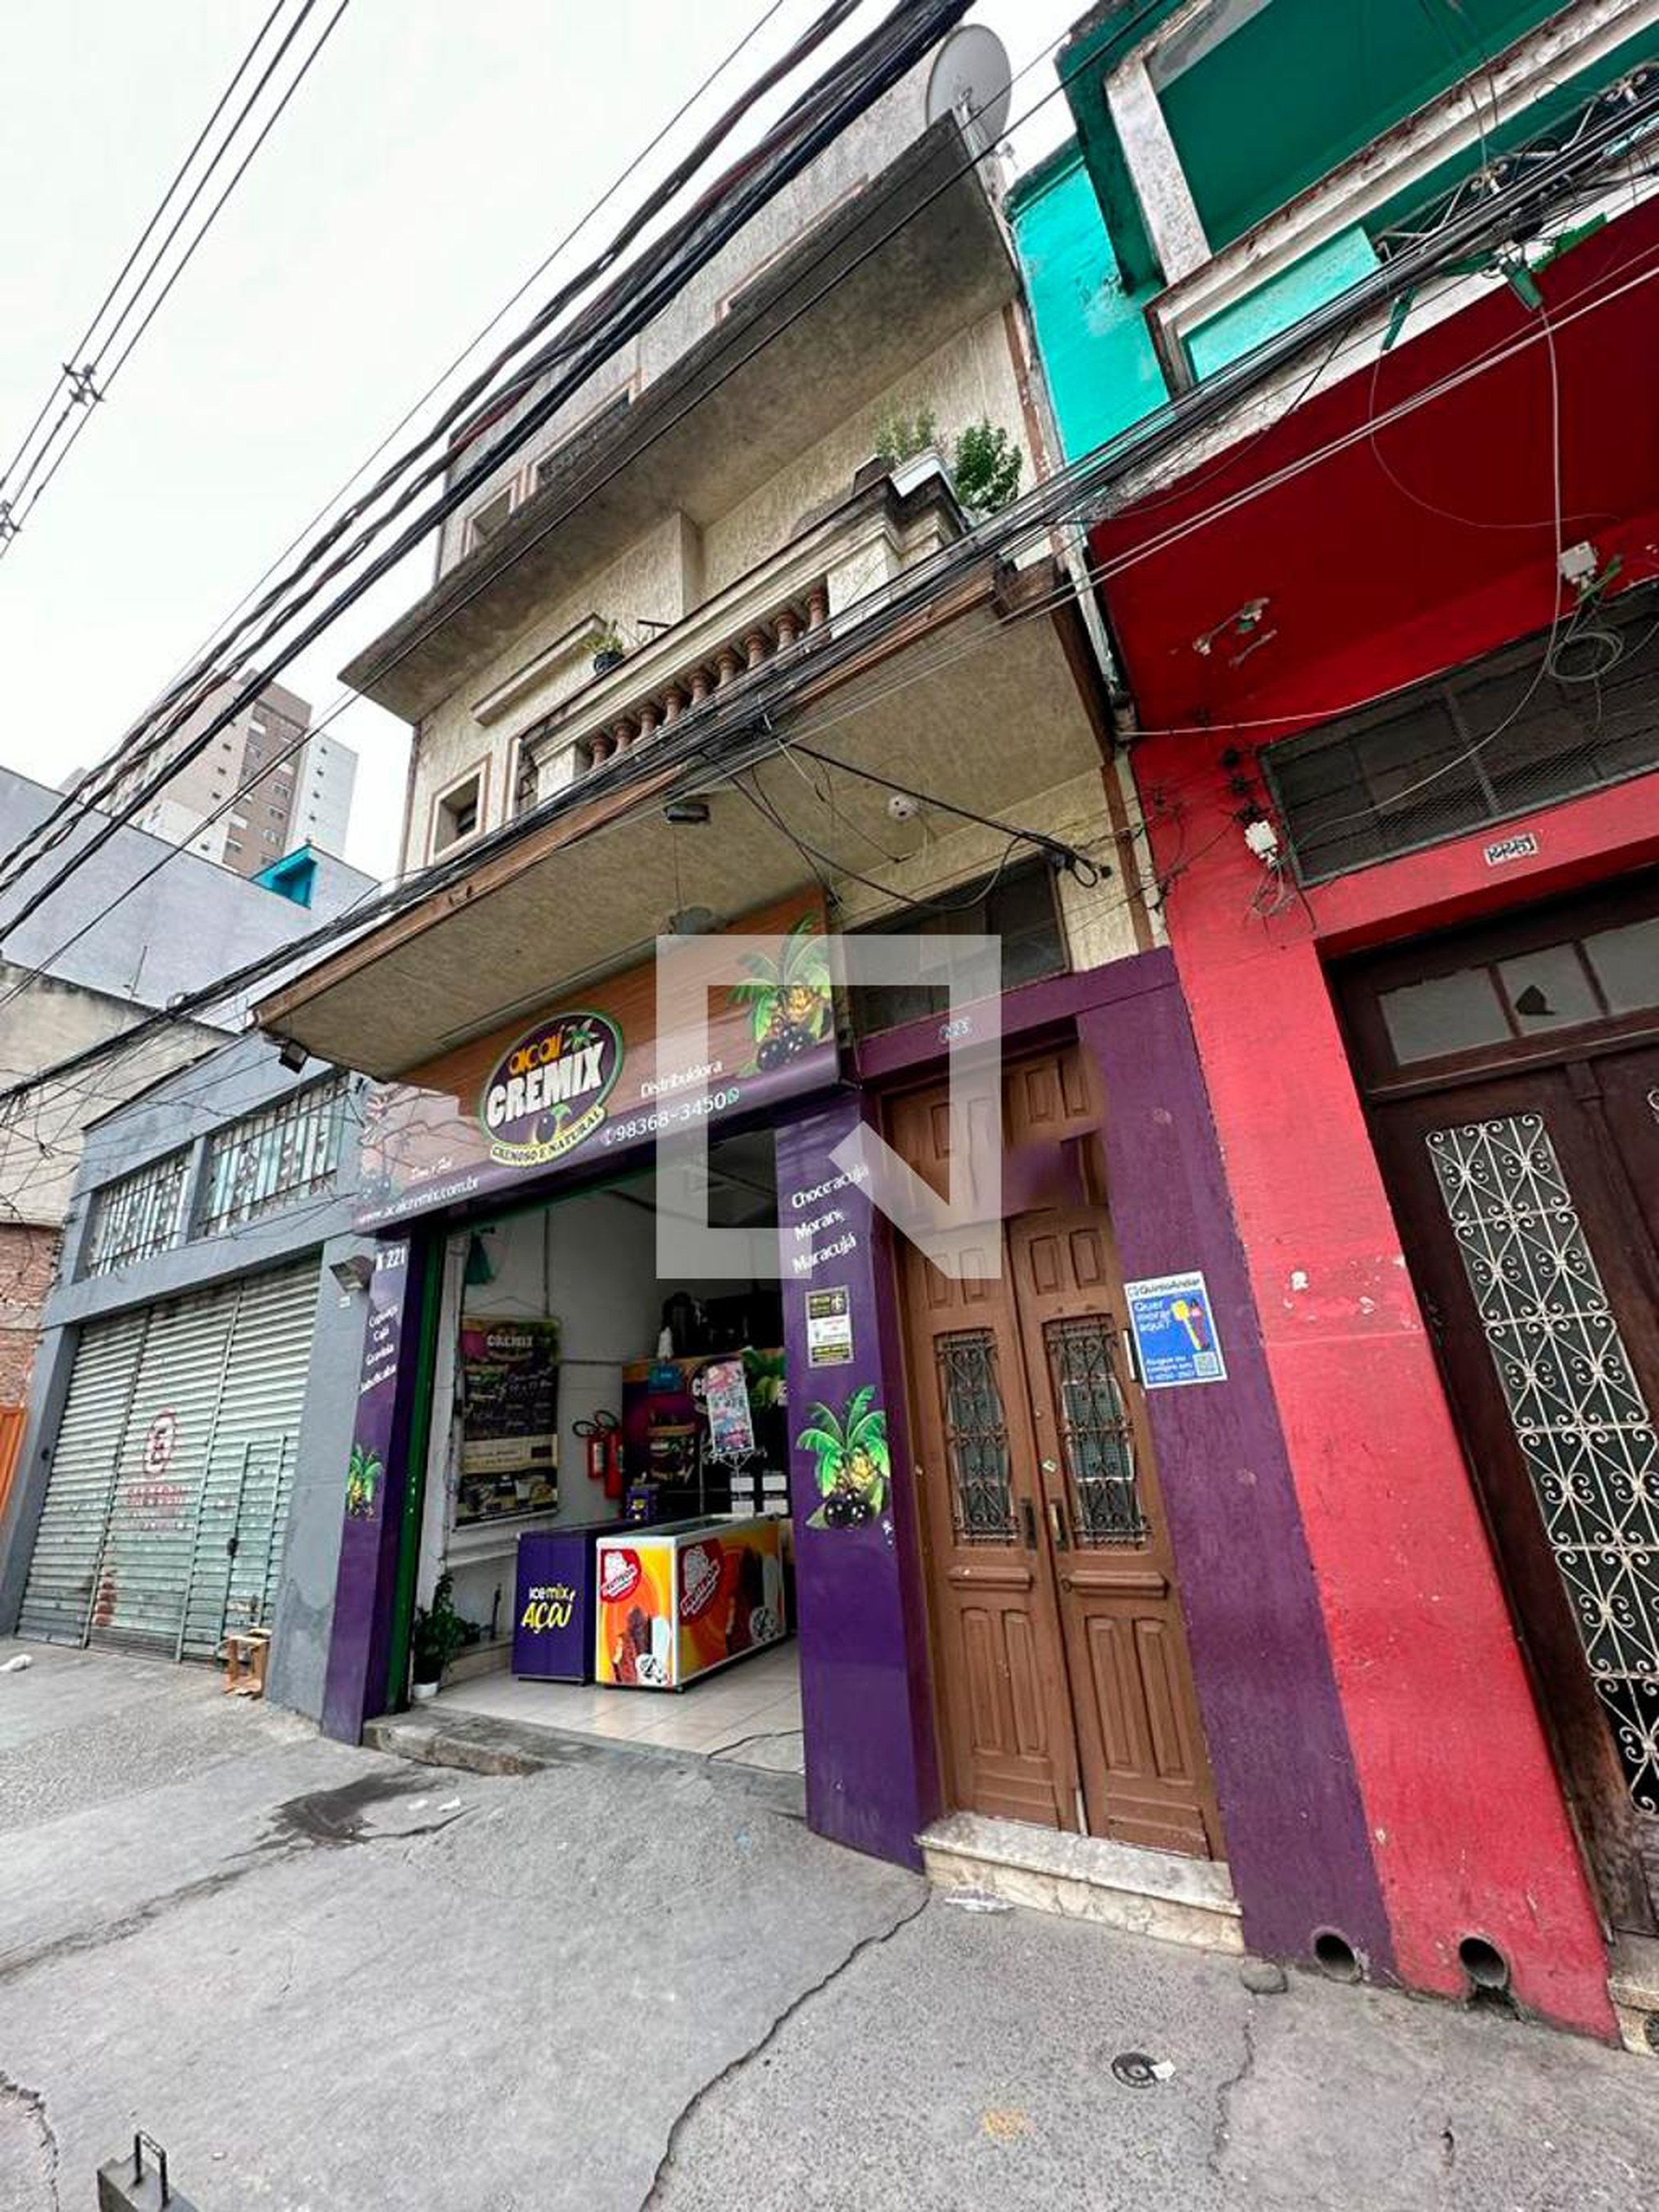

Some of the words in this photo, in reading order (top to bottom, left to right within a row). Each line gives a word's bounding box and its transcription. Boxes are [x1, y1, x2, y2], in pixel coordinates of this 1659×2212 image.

[487, 1041, 604, 1127] CREMIX
[641, 1061, 723, 1098] Distribuidora
[548, 1110, 600, 1152] NATURAL
[615, 1091, 726, 1141] 98368-3450
[386, 1244, 405, 1269] 221
[792, 1232, 857, 1273] Maracujá
[1134, 1300, 1163, 1311] Quer
[1140, 1279, 1200, 1294] QuintoAndar
